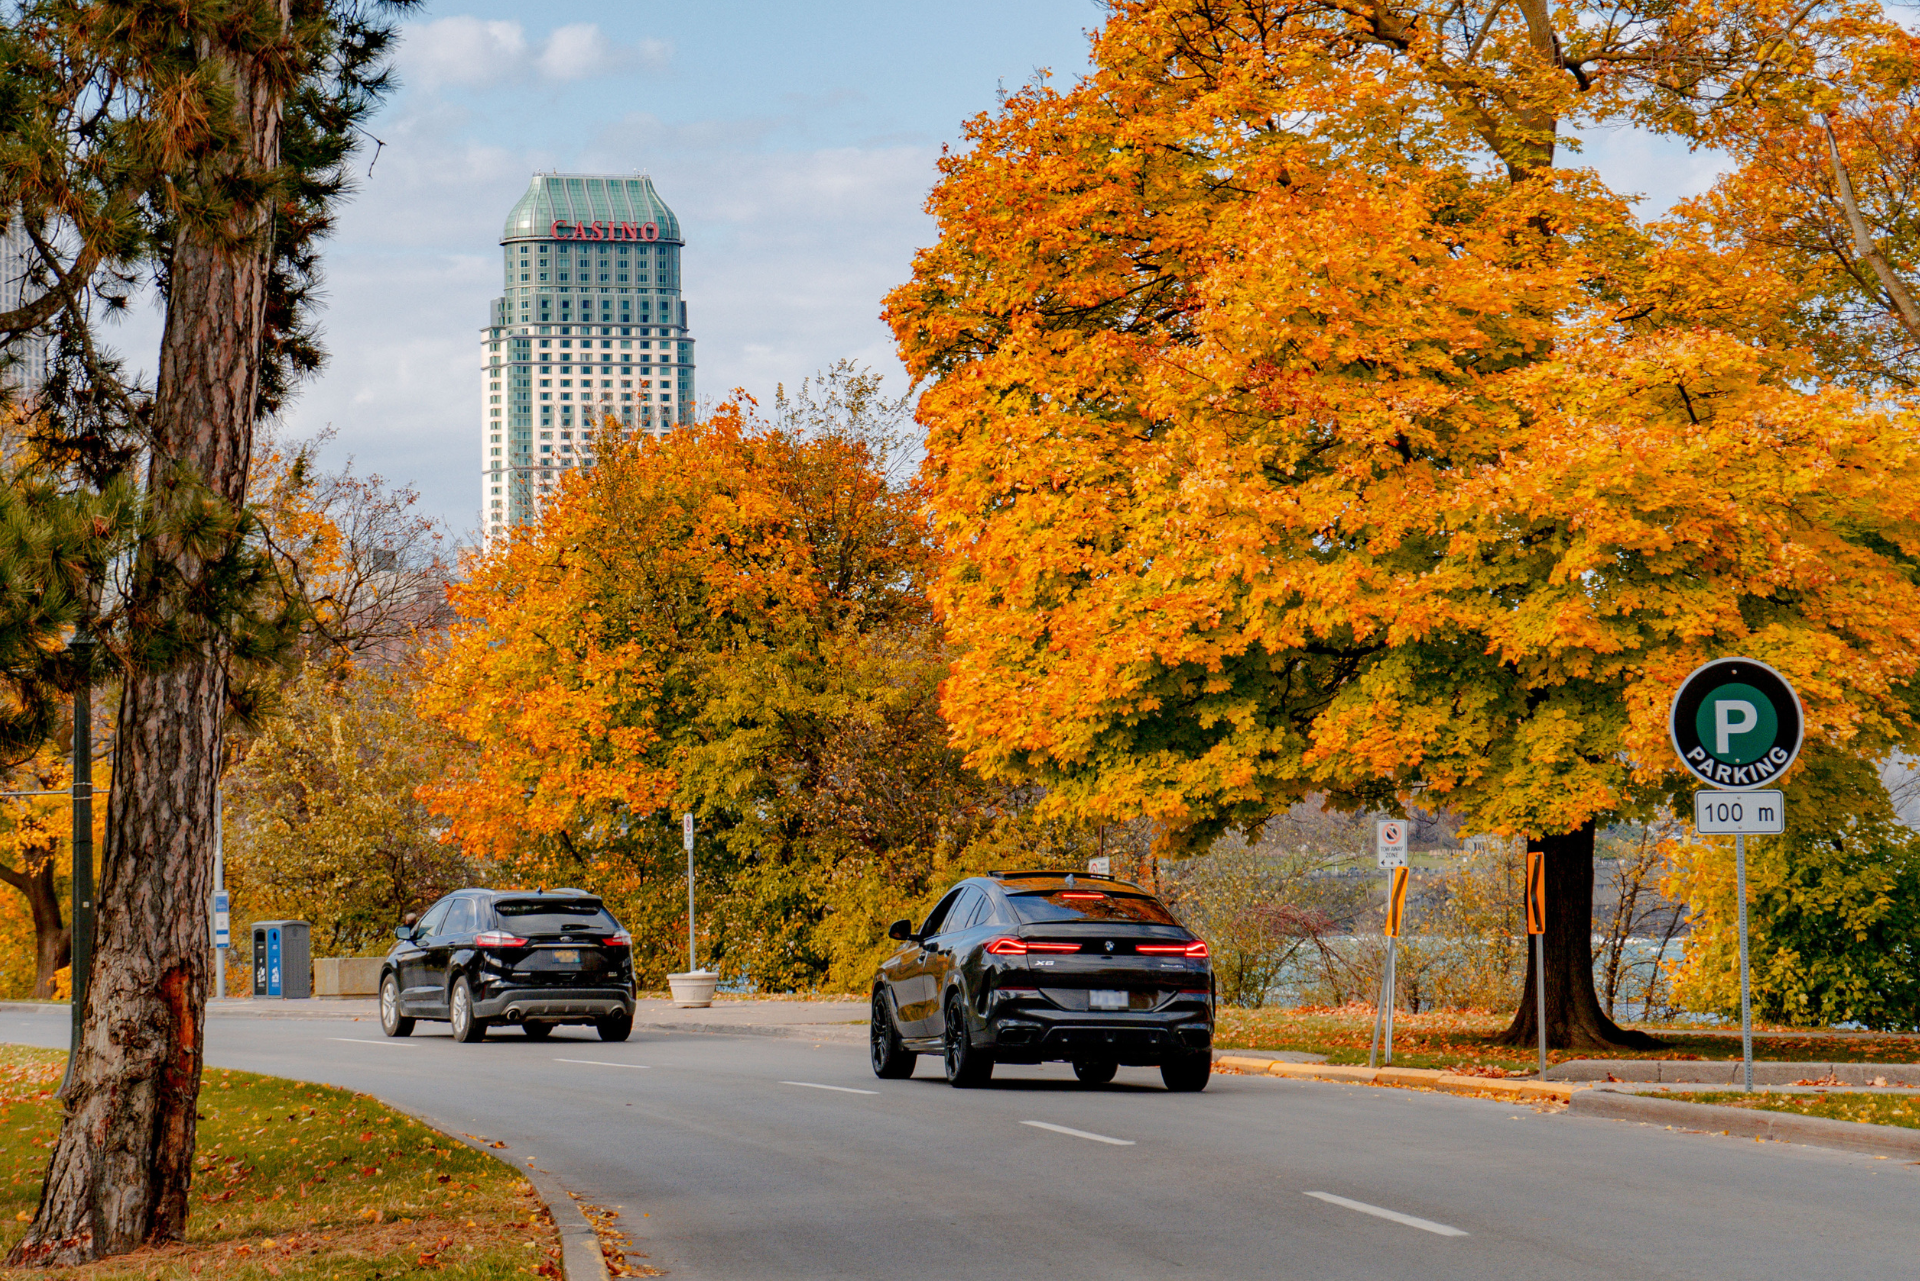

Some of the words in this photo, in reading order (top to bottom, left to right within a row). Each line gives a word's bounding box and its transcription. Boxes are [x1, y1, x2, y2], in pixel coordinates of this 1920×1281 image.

[551, 219, 660, 242] CASINO
[1715, 700, 1758, 754] P
[1686, 746, 1788, 784] PARKING
[1704, 803, 1743, 822] 100
[1758, 806, 1774, 822] m
